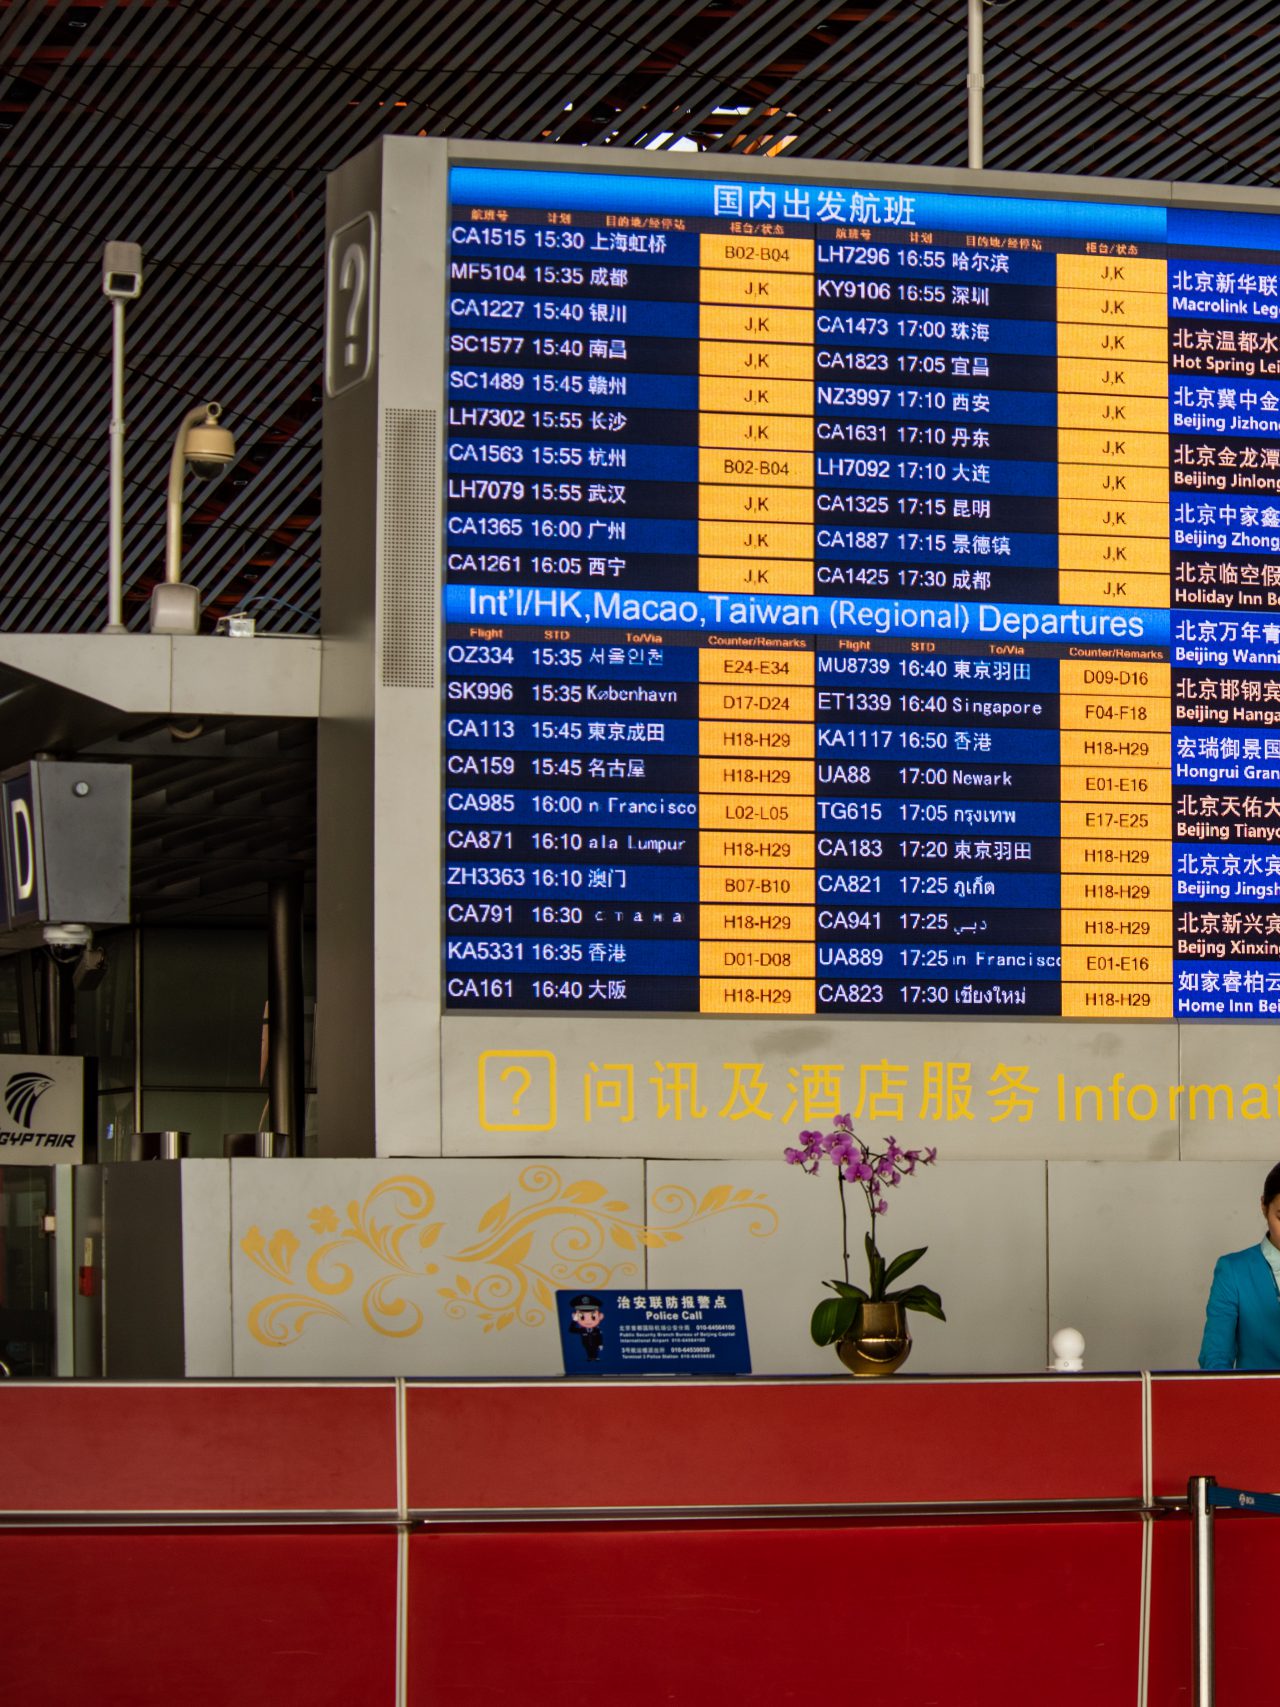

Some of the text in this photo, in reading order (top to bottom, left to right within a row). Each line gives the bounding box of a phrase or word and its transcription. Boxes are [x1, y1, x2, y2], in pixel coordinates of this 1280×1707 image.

[714, 184, 916, 227] 国内出发航班
[548, 212, 572, 225] 计划
[452, 226, 585, 250] CA1515 15:30
[590, 232, 667, 254] 上海虹桥
[725, 245, 790, 262] B02-B04
[818, 245, 946, 268] LH7296 16:55
[952, 251, 1009, 273] 哈尔滨
[451, 262, 584, 285] MF5104 15:35
[590, 267, 628, 288] 成都
[1101, 266, 1124, 280] J,K
[744, 282, 769, 295] J,K
[451, 298, 584, 321] CA1227 15:40
[589, 303, 627, 323] 银川
[1173, 296, 1248, 314] Macrolink
[1173, 354, 1202, 369] Hot
[1206, 356, 1255, 376] Spring
[450, 371, 583, 393] SC1489 15:45
[588, 375, 626, 395] 赣州
[818, 387, 946, 409] NZ3997 17:10
[953, 393, 990, 412] 西安
[818, 458, 946, 480] LH7092 17:10
[952, 463, 990, 484] 大连
[817, 530, 946, 552] CA1887 17:15
[952, 534, 1011, 555] 景德镇
[1175, 530, 1227, 549] Beijing
[1103, 546, 1127, 561] J,K
[448, 554, 582, 574] CA1261 16:05
[588, 557, 626, 577] 西宁
[830, 600, 970, 632] (Regional)
[979, 605, 1144, 638] Departures
[470, 628, 806, 649] Flight STD To/Via Counter/Remarks
[448, 645, 582, 667] OZ334 15:35
[589, 648, 664, 666] 서울인천
[724, 659, 790, 675] E24-E34
[819, 657, 947, 677] MU8739 16:40
[953, 660, 1030, 681] 東京羽田
[1084, 669, 1148, 686] D09-D16
[448, 682, 582, 703] SK996 15:35
[818, 692, 947, 713] ET1339 16:40
[723, 695, 790, 711] D17-D24
[952, 697, 1042, 717] Singapore
[1085, 704, 1147, 721] F04-F18
[448, 719, 582, 740] CA113 15:45
[588, 722, 664, 742] 東京成田
[723, 732, 791, 748] H18-H29
[818, 765, 947, 785] UA88 17:00
[953, 770, 1012, 786] Newark
[1177, 763, 1239, 782] Hongrui
[1086, 777, 1148, 792] E01-E16
[817, 802, 948, 822] TG615 17:05
[954, 809, 1016, 826] กรุงเทพ
[1086, 812, 1149, 828] E17-E25
[11, 798, 34, 899] D
[818, 875, 948, 894] CA821 17:25
[953, 875, 995, 897] ภูเก็ต
[818, 911, 948, 930] CA941 17:25
[1178, 939, 1226, 958] Beijng
[818, 984, 949, 1003] CA823 17:30
[1085, 993, 1151, 1006] H18-H29
[1178, 998, 1225, 1013] Home
[1229, 999, 1253, 1012] Inn
[583, 1058, 1041, 1124] 问讯及酒店服务
[617, 1296, 727, 1309] 治安联防报警点
[646, 1311, 702, 1320] Police Call
